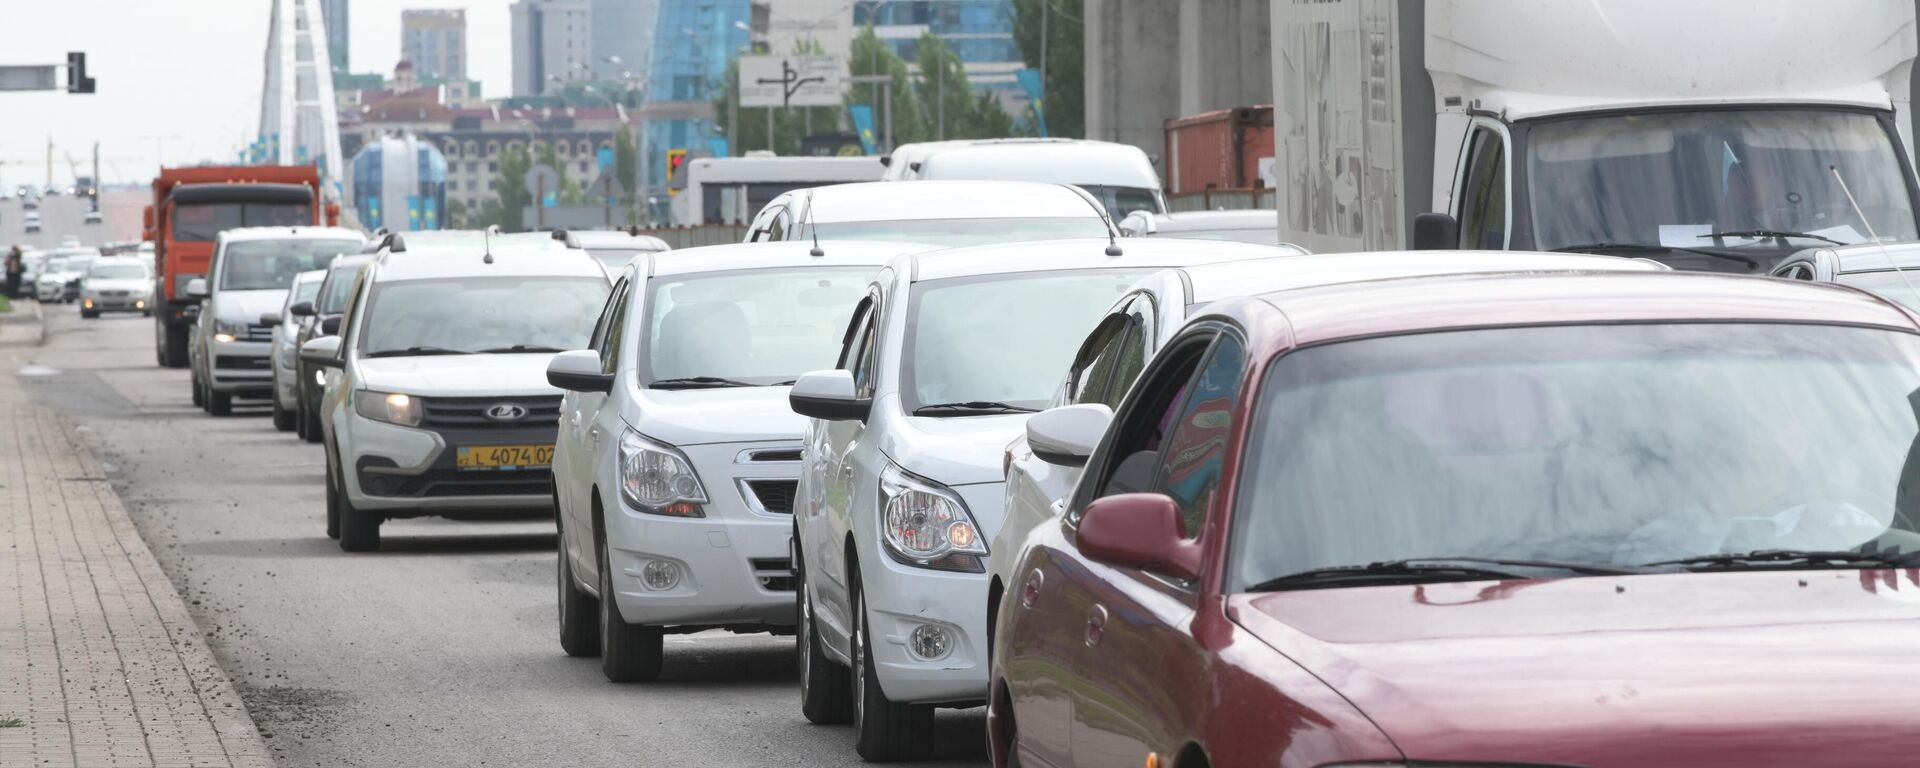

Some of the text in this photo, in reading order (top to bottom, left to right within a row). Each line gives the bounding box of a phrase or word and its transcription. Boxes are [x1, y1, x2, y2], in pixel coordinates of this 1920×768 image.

[475, 452, 485, 465] L
[490, 447, 530, 465] 4074
[536, 447, 554, 464] 02
